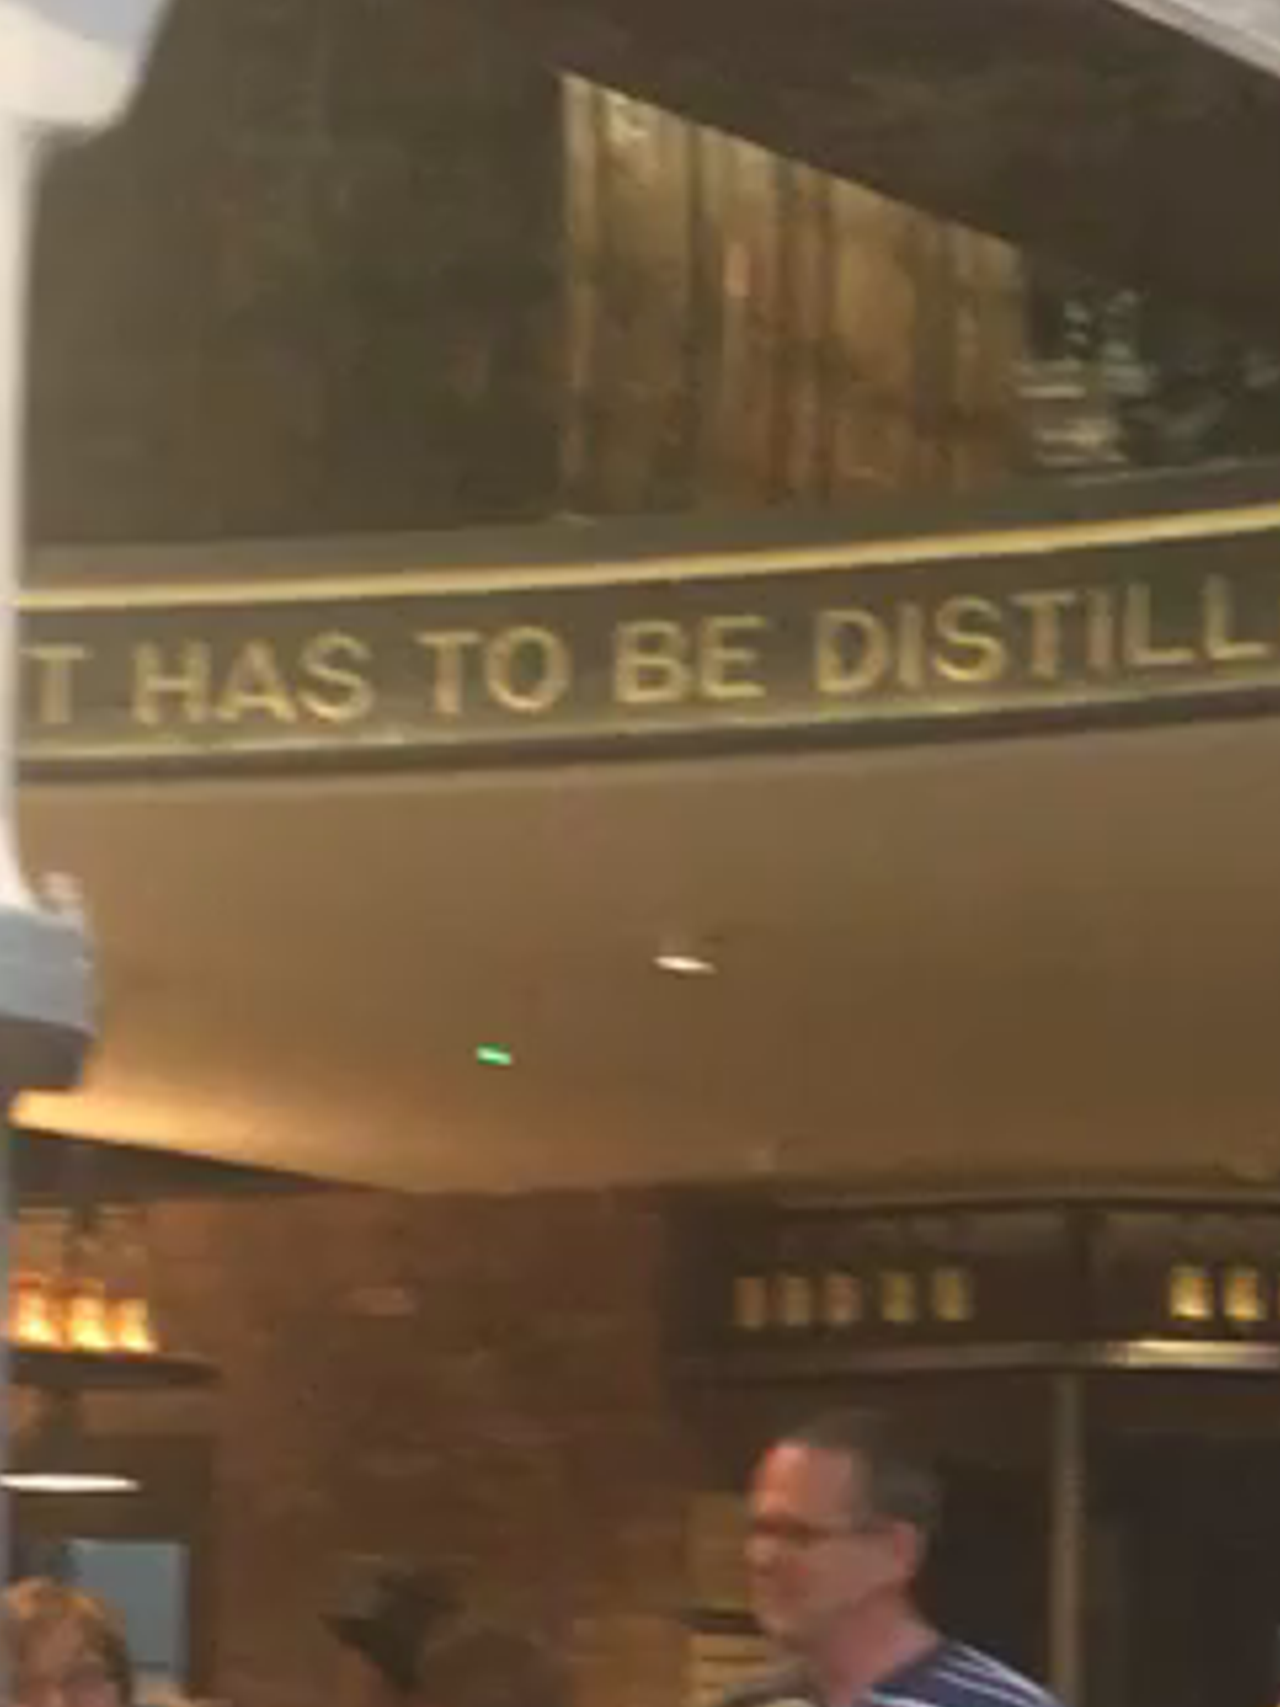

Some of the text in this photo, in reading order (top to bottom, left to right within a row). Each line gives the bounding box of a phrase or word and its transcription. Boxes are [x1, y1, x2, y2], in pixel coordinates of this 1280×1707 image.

[131, 630, 374, 726] HAS
[416, 624, 570, 717] TO
[615, 615, 767, 703] BE
